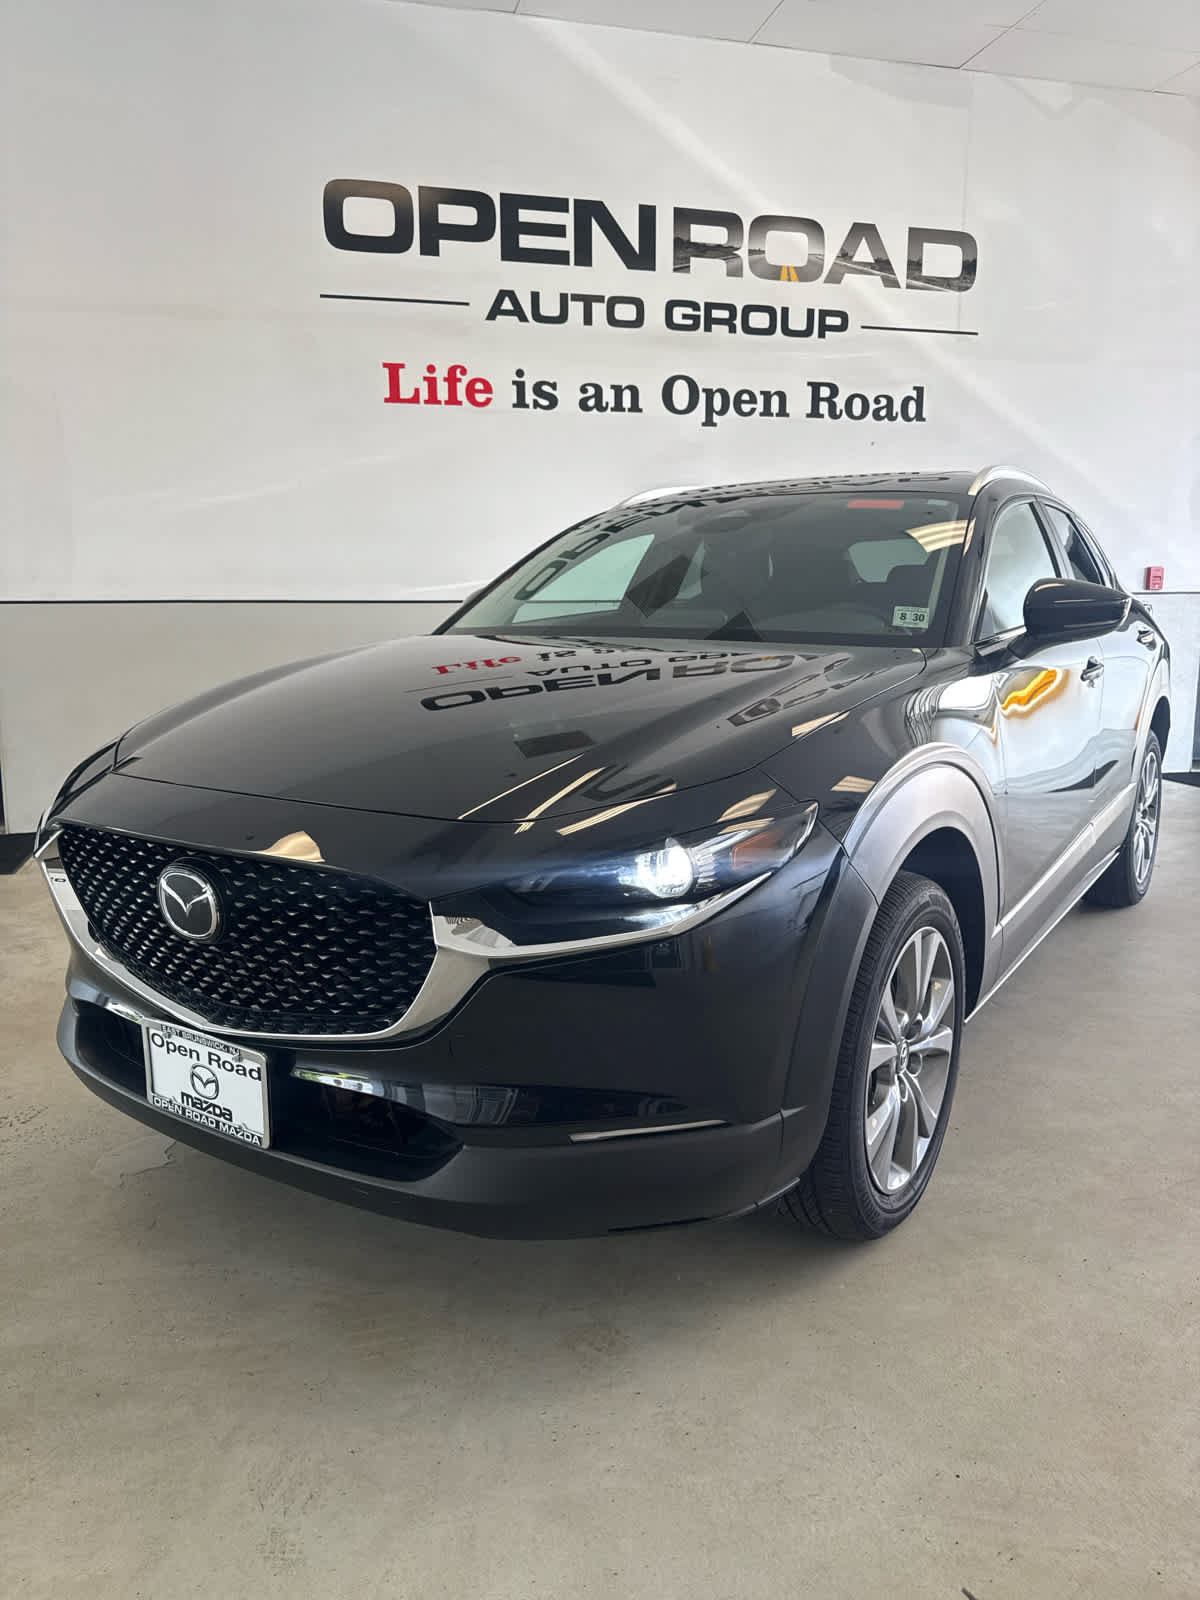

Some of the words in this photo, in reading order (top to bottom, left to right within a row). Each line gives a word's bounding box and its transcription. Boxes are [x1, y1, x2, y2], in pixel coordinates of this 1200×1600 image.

[322, 178, 657, 272] OPEN
[673, 206, 978, 292] ROAD
[485, 289, 645, 329] AUTO
[664, 299, 849, 339] GROUP
[382, 362, 493, 411] Life
[511, 368, 559, 411] is
[578, 382, 643, 413] an
[661, 374, 790, 427] Open
[805, 381, 927, 423] Road
[151, 1032, 200, 1061] Open
[207, 1051, 262, 1081] Road
[152, 1096, 183, 1115] OPEN
[185, 1109, 217, 1129] ROAD
[219, 1121, 264, 1147] MAZDA
